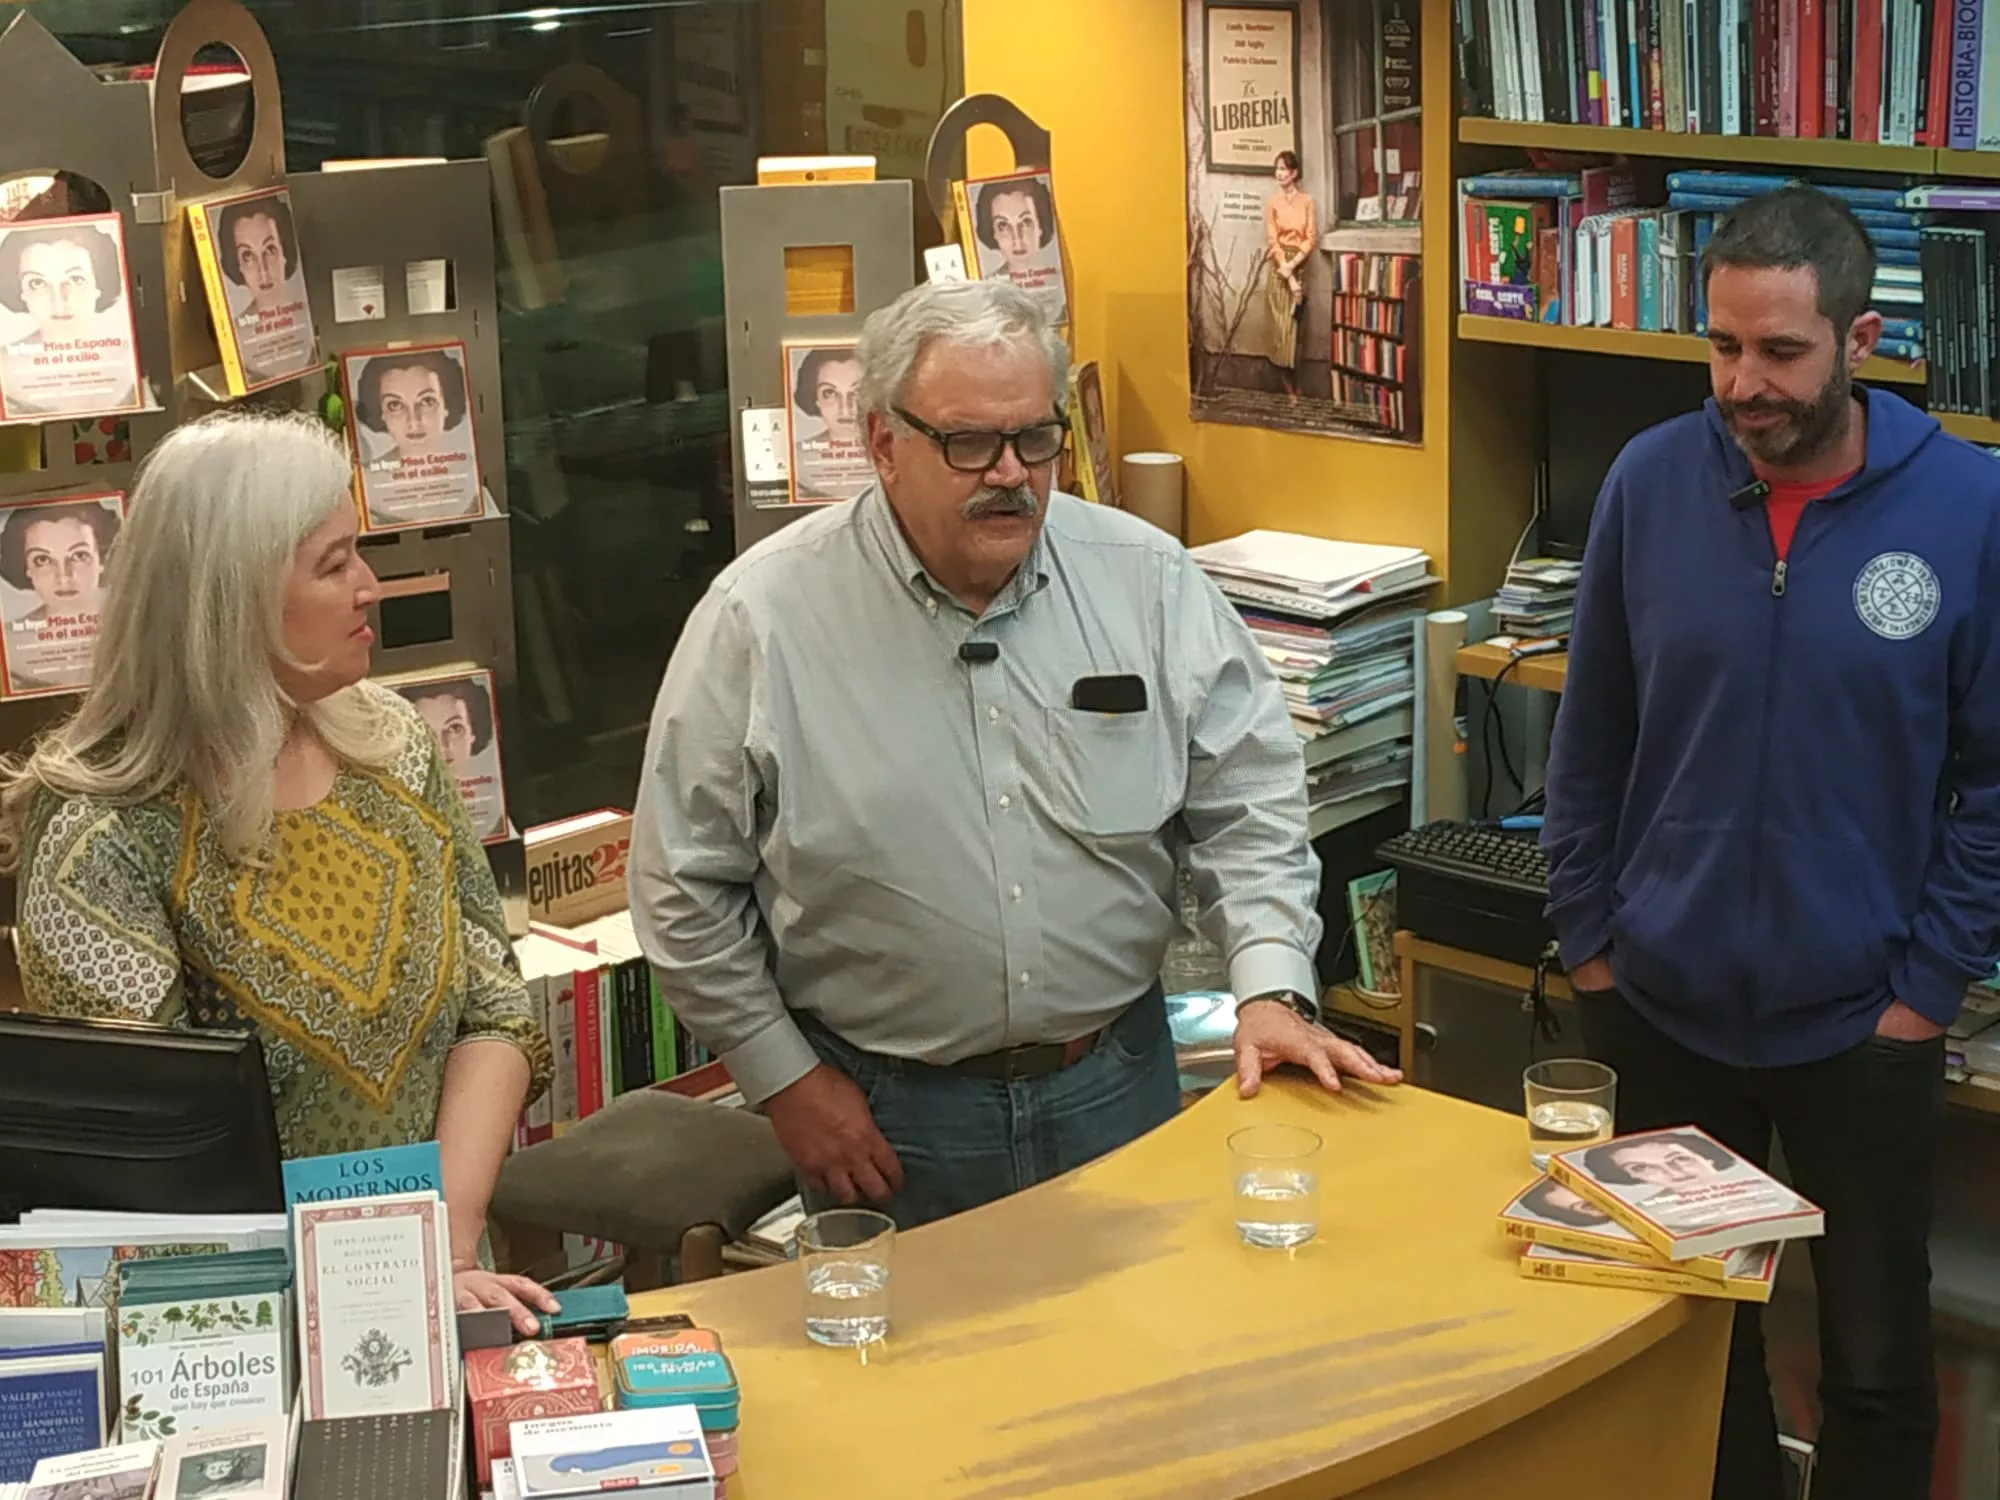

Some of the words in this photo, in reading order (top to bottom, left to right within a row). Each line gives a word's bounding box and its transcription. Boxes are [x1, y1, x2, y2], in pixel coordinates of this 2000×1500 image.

[1212, 90, 1291, 132] LIBRERÍA
[43, 340, 73, 353] Miss
[74, 337, 121, 351] España
[33, 356, 49, 366] en
[51, 353, 64, 364] el
[66, 351, 101, 363] exilio
[338, 1157, 385, 1178] LOS
[296, 1174, 433, 1204] MODERNOS
[322, 1266, 339, 1275] EL
[344, 1259, 419, 1274] CONTRATO
[346, 1275, 396, 1287] SOCIAL
[130, 1369, 165, 1386] 101
[170, 1351, 276, 1383] Árboles
[170, 1384, 190, 1399] de
[194, 1380, 250, 1400] España
